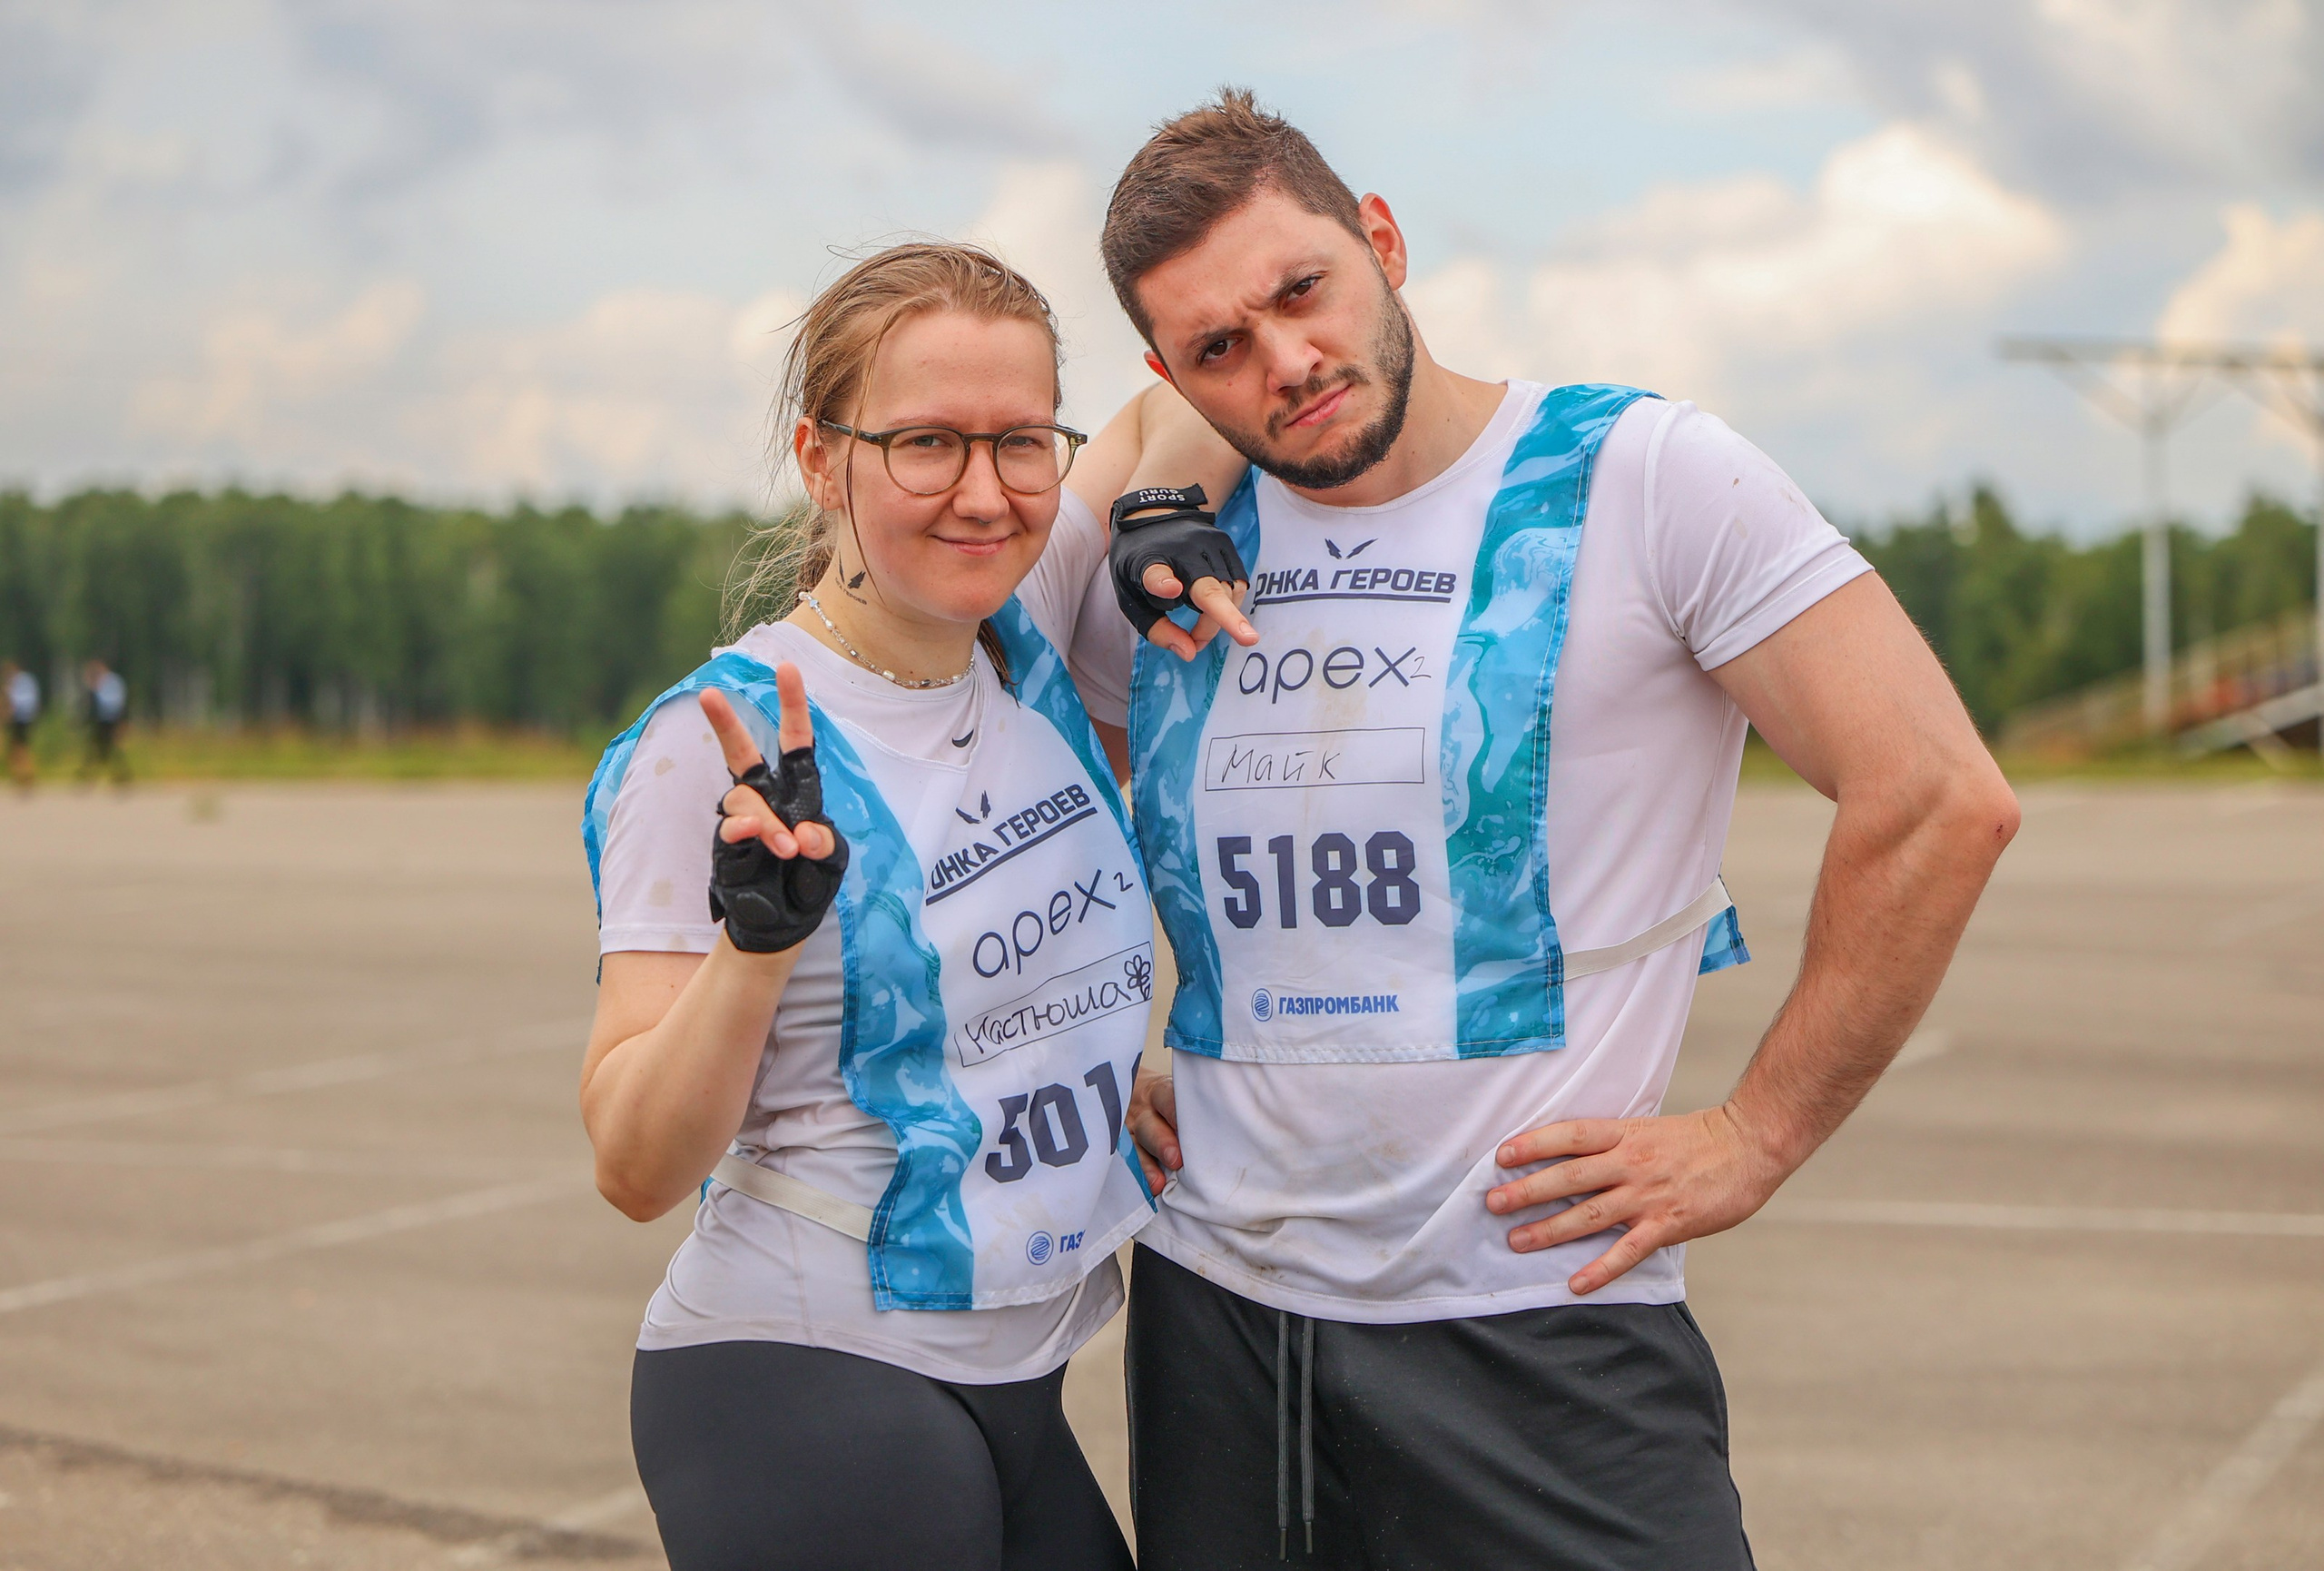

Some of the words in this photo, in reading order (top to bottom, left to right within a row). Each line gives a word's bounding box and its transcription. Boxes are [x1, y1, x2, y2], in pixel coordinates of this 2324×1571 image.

[1139, 489, 1179, 497] GURU
[1139, 494, 1186, 504] SPORT
[1255, 568, 1319, 596] ОНКА
[1330, 568, 1457, 594] ГЕРОЕВ
[1238, 647, 1416, 705] apex
[1221, 744, 1340, 784] Майк
[930, 842, 1000, 891] ОНКА
[992, 784, 1091, 846] ГЕРОЕВ
[1216, 831, 1422, 930] 5188
[972, 869, 1117, 978] apex
[1277, 993, 1400, 1016] ГАЗПРОМБАНК
[984, 1051, 1142, 1183] 501
[1059, 1230, 1086, 1253] ГАЗ
